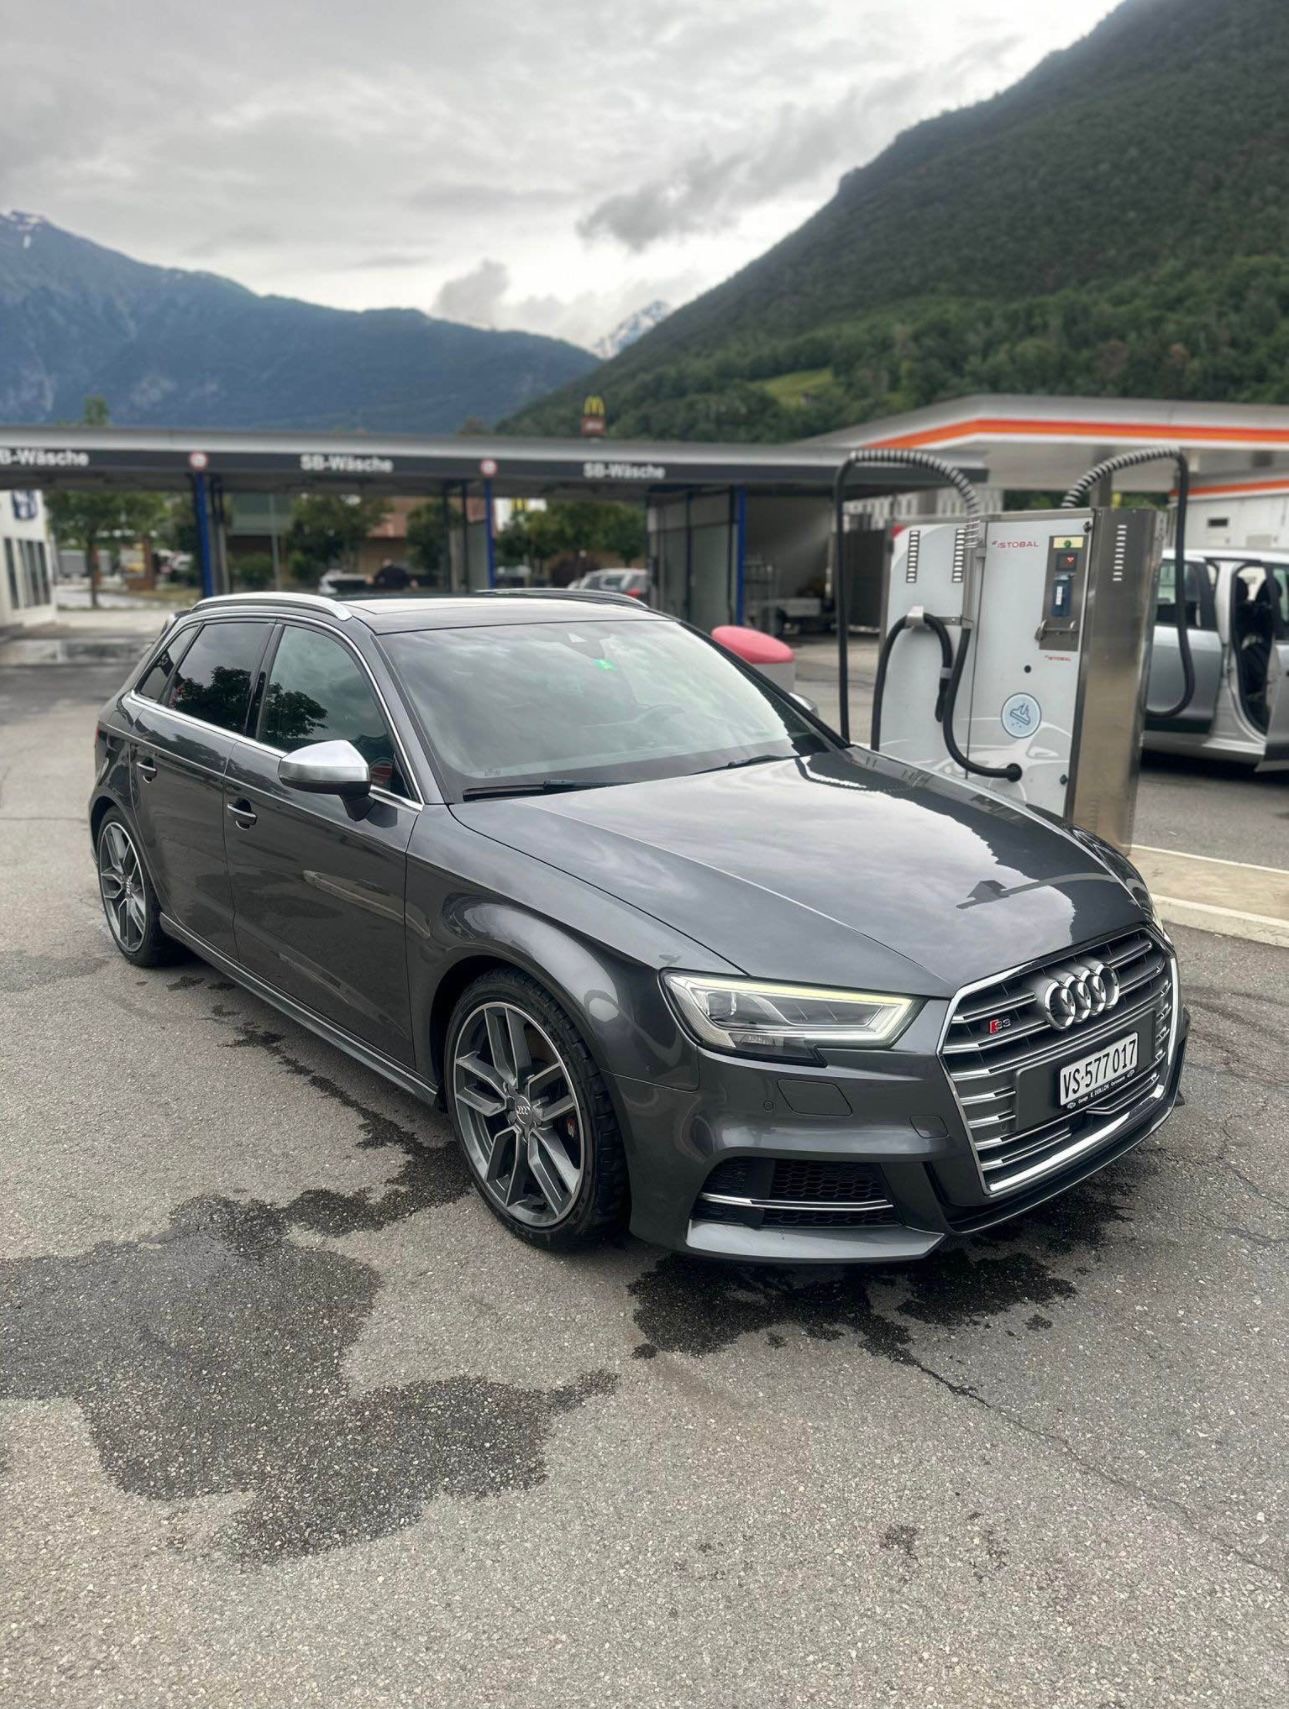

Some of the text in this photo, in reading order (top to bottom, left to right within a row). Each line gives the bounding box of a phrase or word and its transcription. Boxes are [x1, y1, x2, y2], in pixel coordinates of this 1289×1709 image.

[0, 448, 90, 466] B-Wäsche
[300, 454, 394, 473] SB-Wäsche
[583, 462, 666, 479] SB-Wäsche
